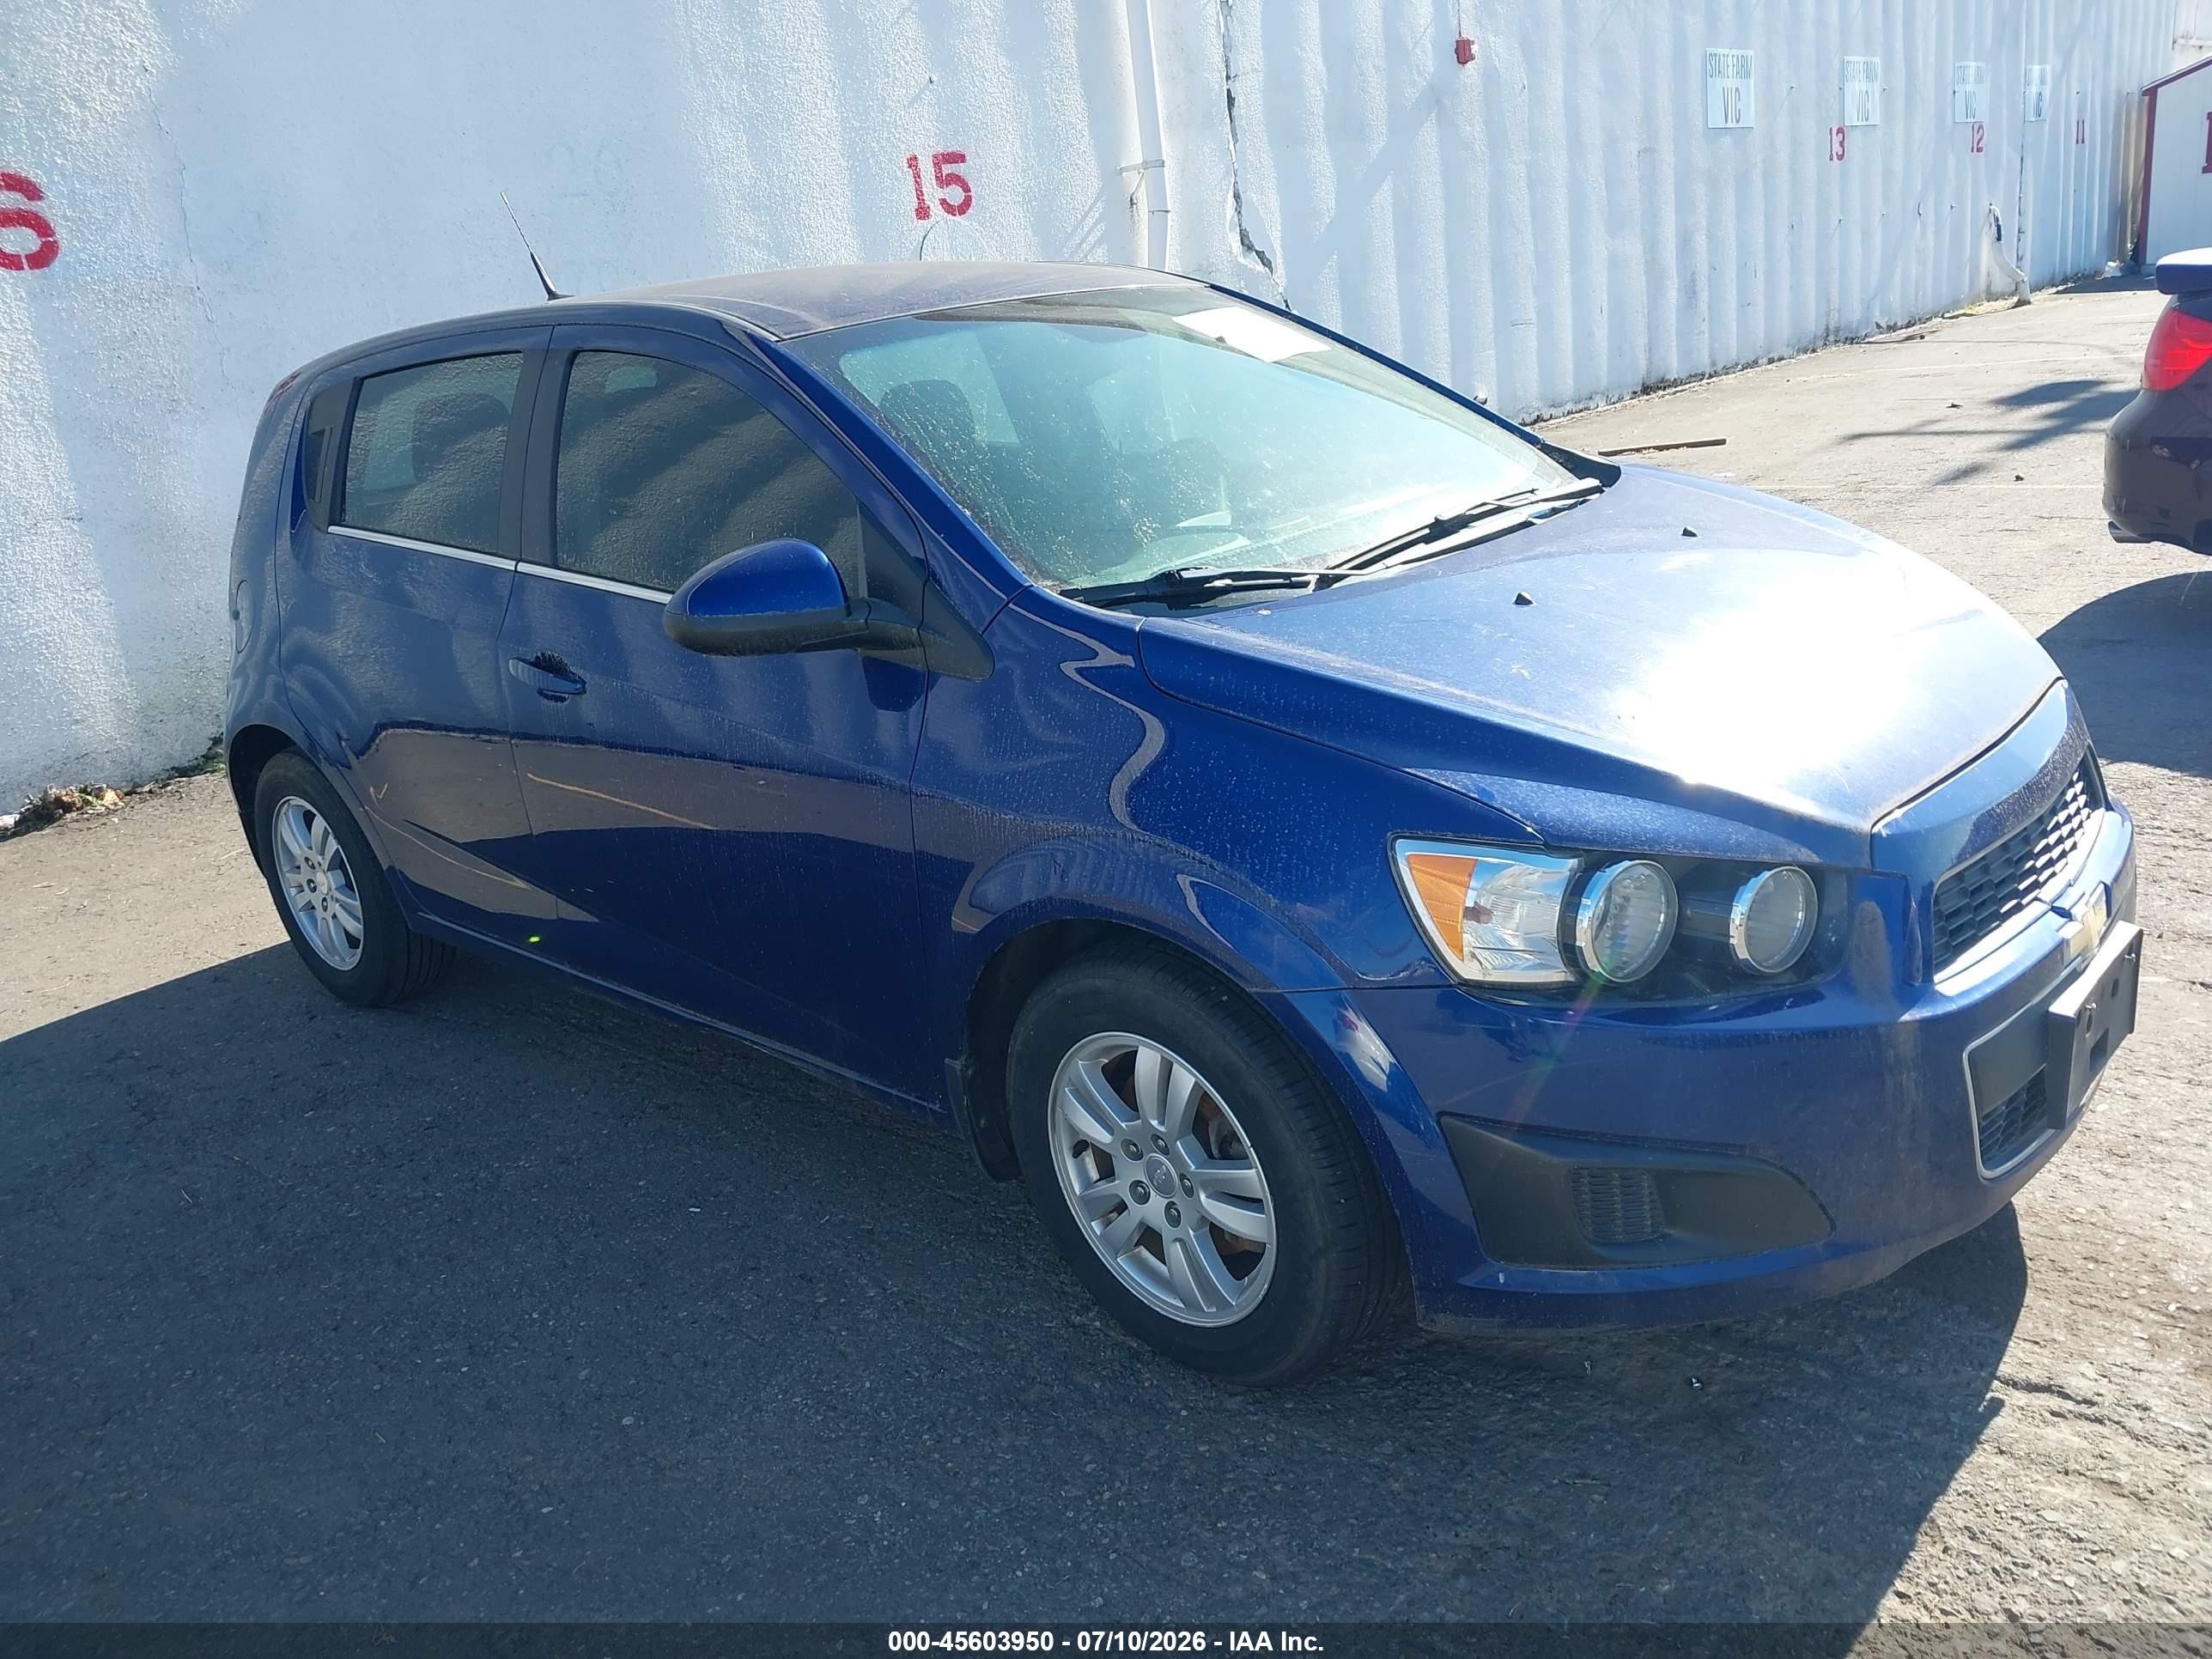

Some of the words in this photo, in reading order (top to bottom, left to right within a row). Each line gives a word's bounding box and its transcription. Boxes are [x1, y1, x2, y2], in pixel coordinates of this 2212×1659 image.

[1708, 52, 1730, 79] STATE
[1731, 53, 1753, 81] FARM
[1845, 60, 1862, 83] STATE
[1863, 61, 1879, 83] FARM
[1722, 86, 1741, 125] VIC
[1856, 89, 1869, 122] VIC
[1965, 90, 1977, 119] VIC
[1829, 126, 1845, 161] 13
[1971, 124, 1984, 153] 12
[2075, 119, 2085, 144] 11
[907, 151, 972, 220] 15
